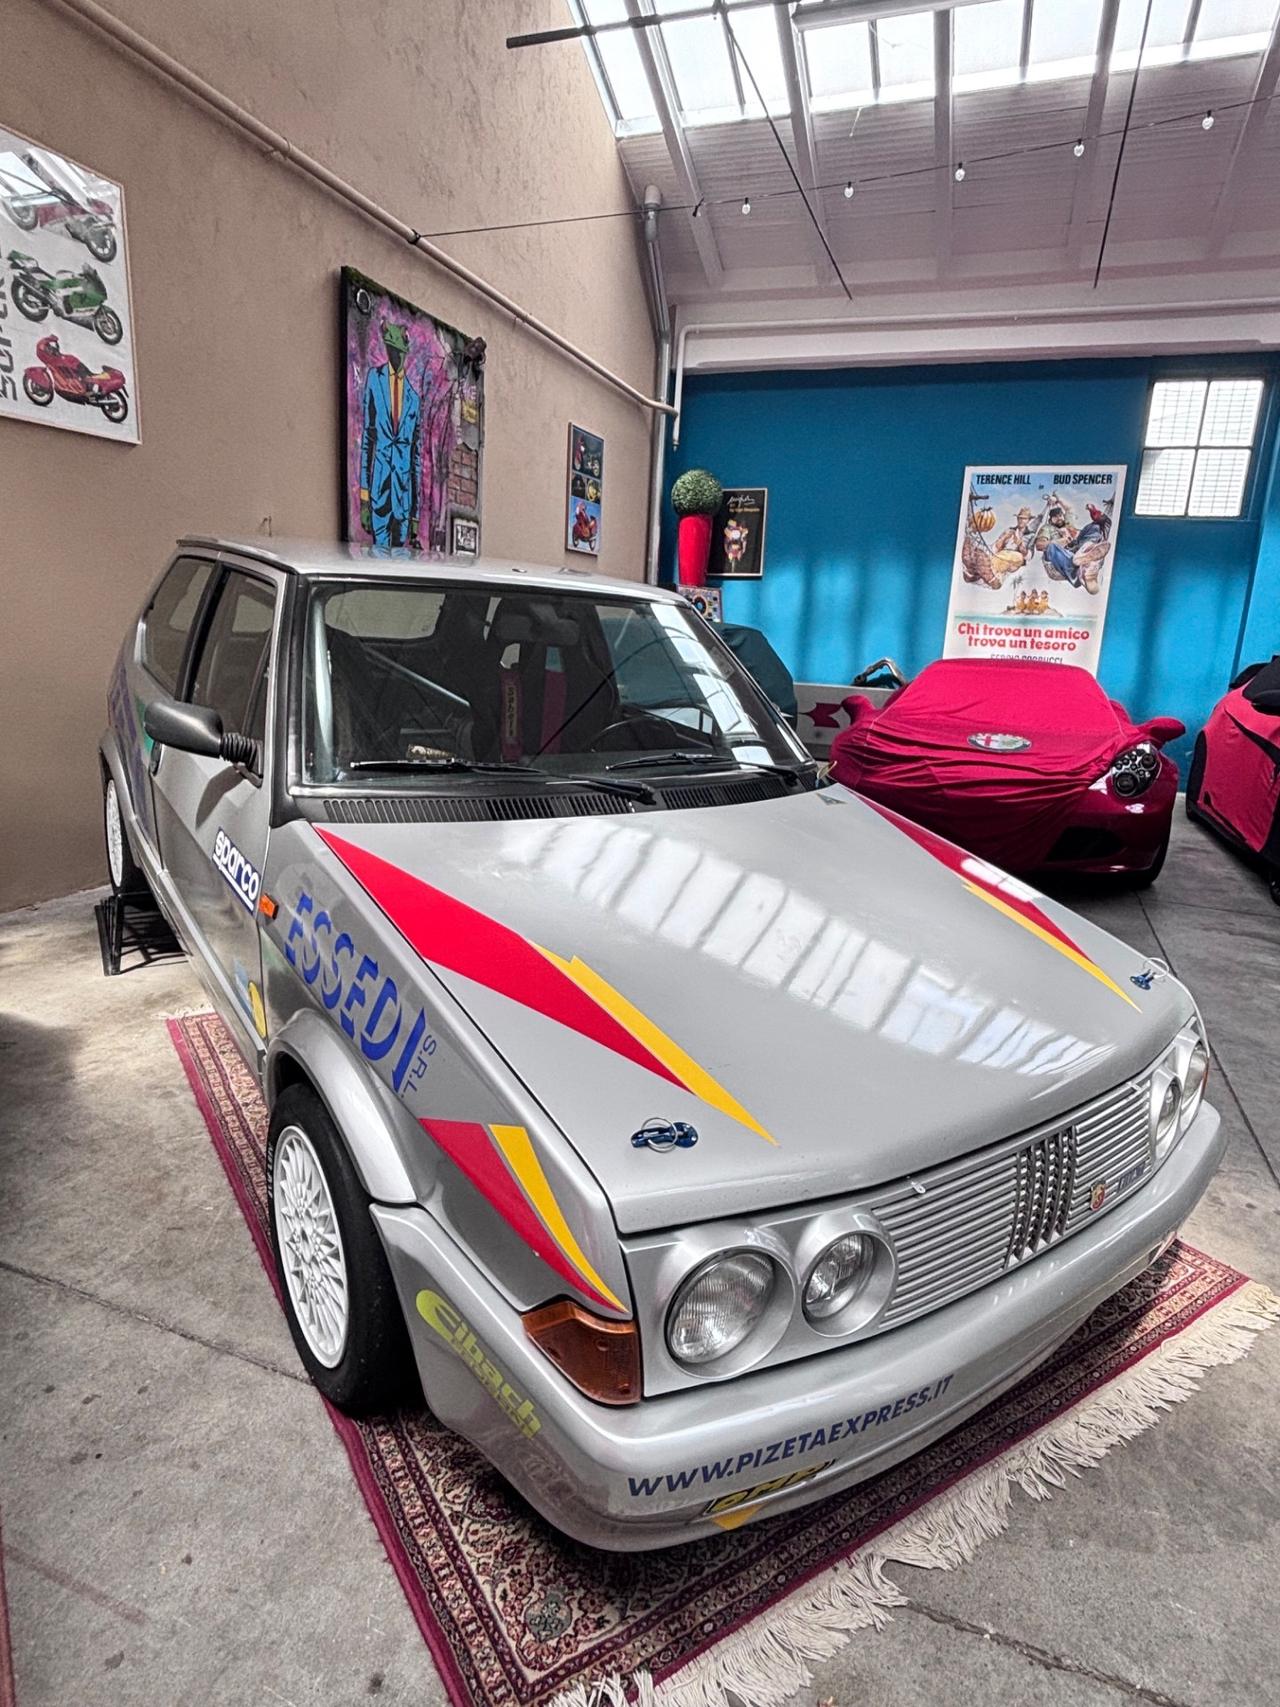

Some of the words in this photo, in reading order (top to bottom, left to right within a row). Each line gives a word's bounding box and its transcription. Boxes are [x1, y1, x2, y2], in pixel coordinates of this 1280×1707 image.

[976, 474, 1012, 485] TERENCE
[1013, 474, 1031, 485] HILL
[1053, 474, 1071, 485] BUD
[1072, 474, 1113, 485] SPENCER
[958, 622, 980, 635] Chi
[983, 624, 1021, 637] trova
[1023, 628, 1042, 638] un
[1044, 627, 1090, 640] amico
[968, 636, 1006, 648] trova
[1009, 640, 1027, 649] un
[1030, 638, 1077, 651] tesoro
[215, 830, 260, 901] sparco
[284, 891, 426, 1093] ESSEDI
[401, 1034, 437, 1099] S.R.L.
[415, 1288, 542, 1432] Eibach
[627, 1374, 955, 1498] WWW.PIZETAEXPRESS.IT
